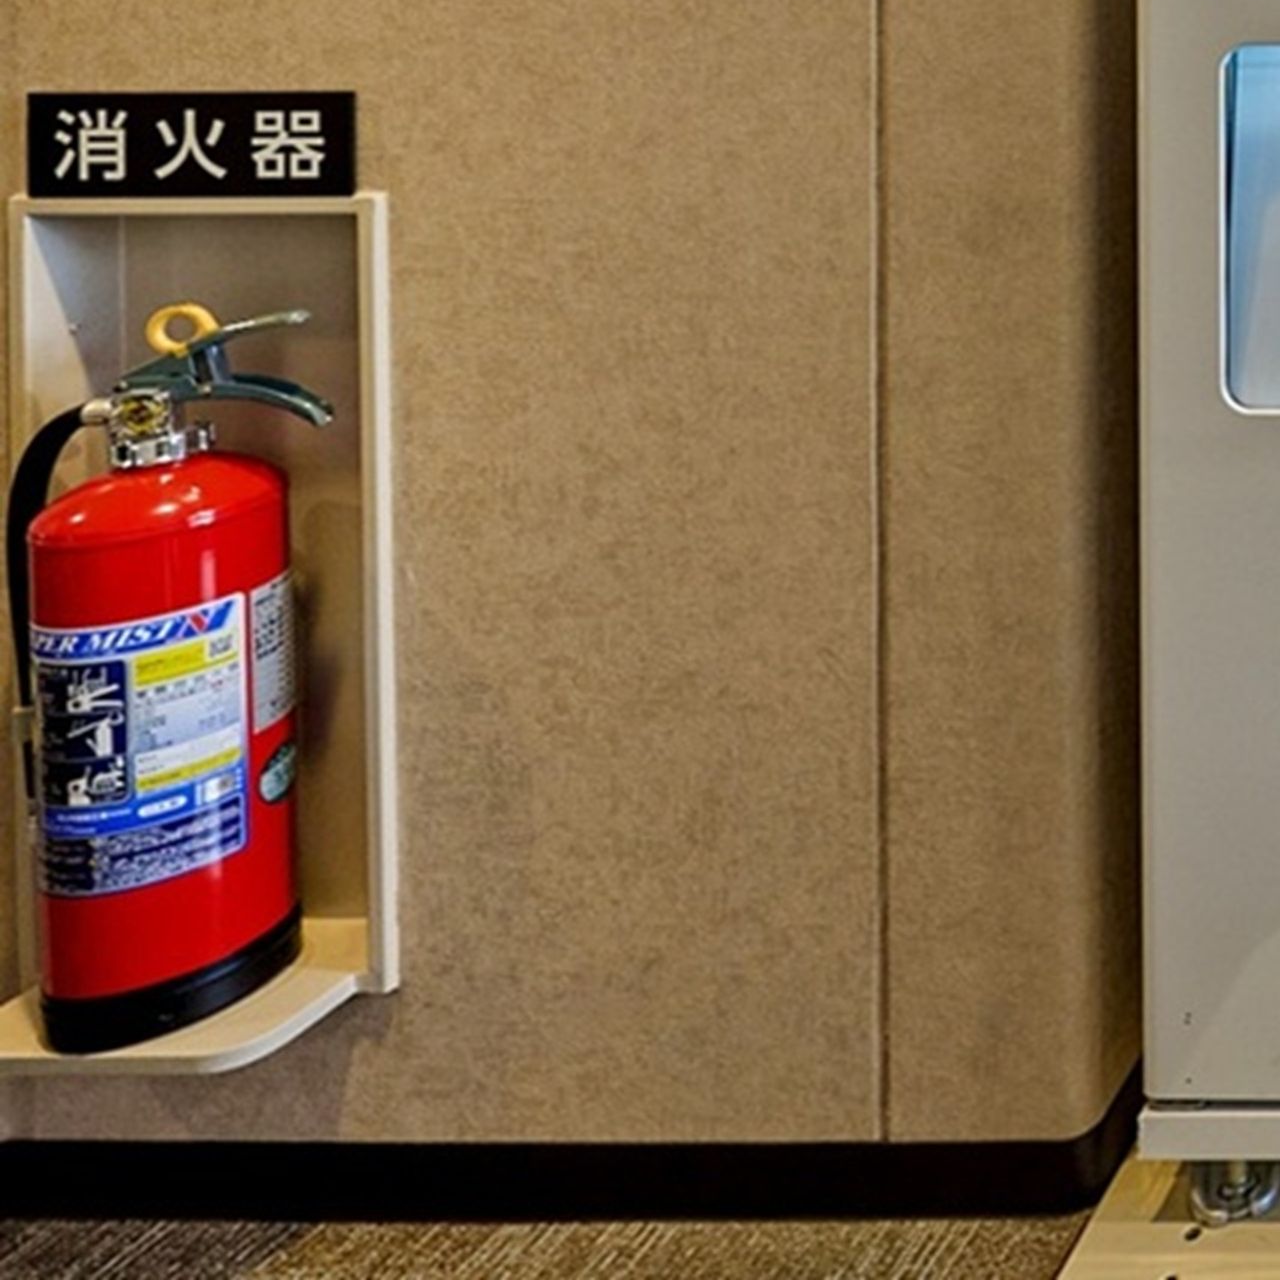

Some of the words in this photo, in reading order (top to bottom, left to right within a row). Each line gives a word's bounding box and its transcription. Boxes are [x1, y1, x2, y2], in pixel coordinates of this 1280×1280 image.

[54, 108, 326, 181] 消火器
[82, 617, 178, 654] MIST
